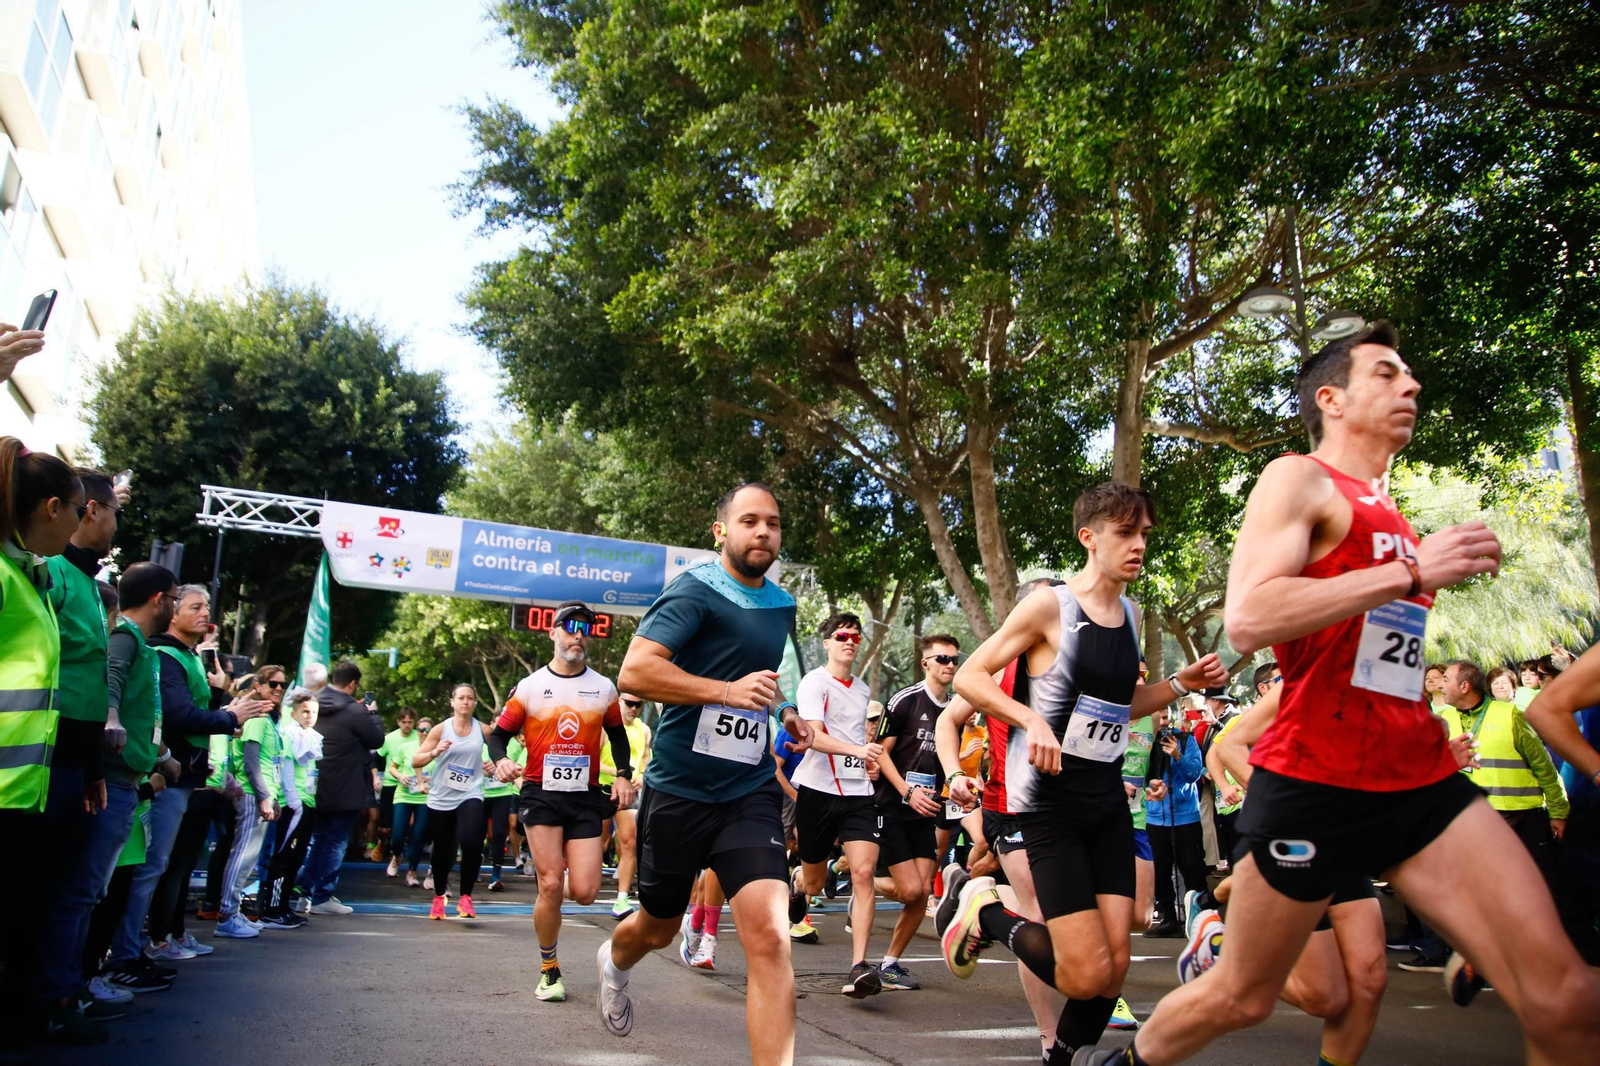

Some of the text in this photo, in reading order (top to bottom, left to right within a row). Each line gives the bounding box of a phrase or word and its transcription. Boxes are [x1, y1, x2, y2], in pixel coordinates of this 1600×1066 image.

[474, 529, 656, 566] Almería en marcha
[472, 554, 632, 584] contra el cáncer
[1379, 631, 1424, 671] 28
[1078, 704, 1096, 713] contra
[715, 714, 759, 743] 504
[1086, 720, 1123, 743] 178
[449, 772, 470, 784] 267
[552, 767, 583, 780] 637
